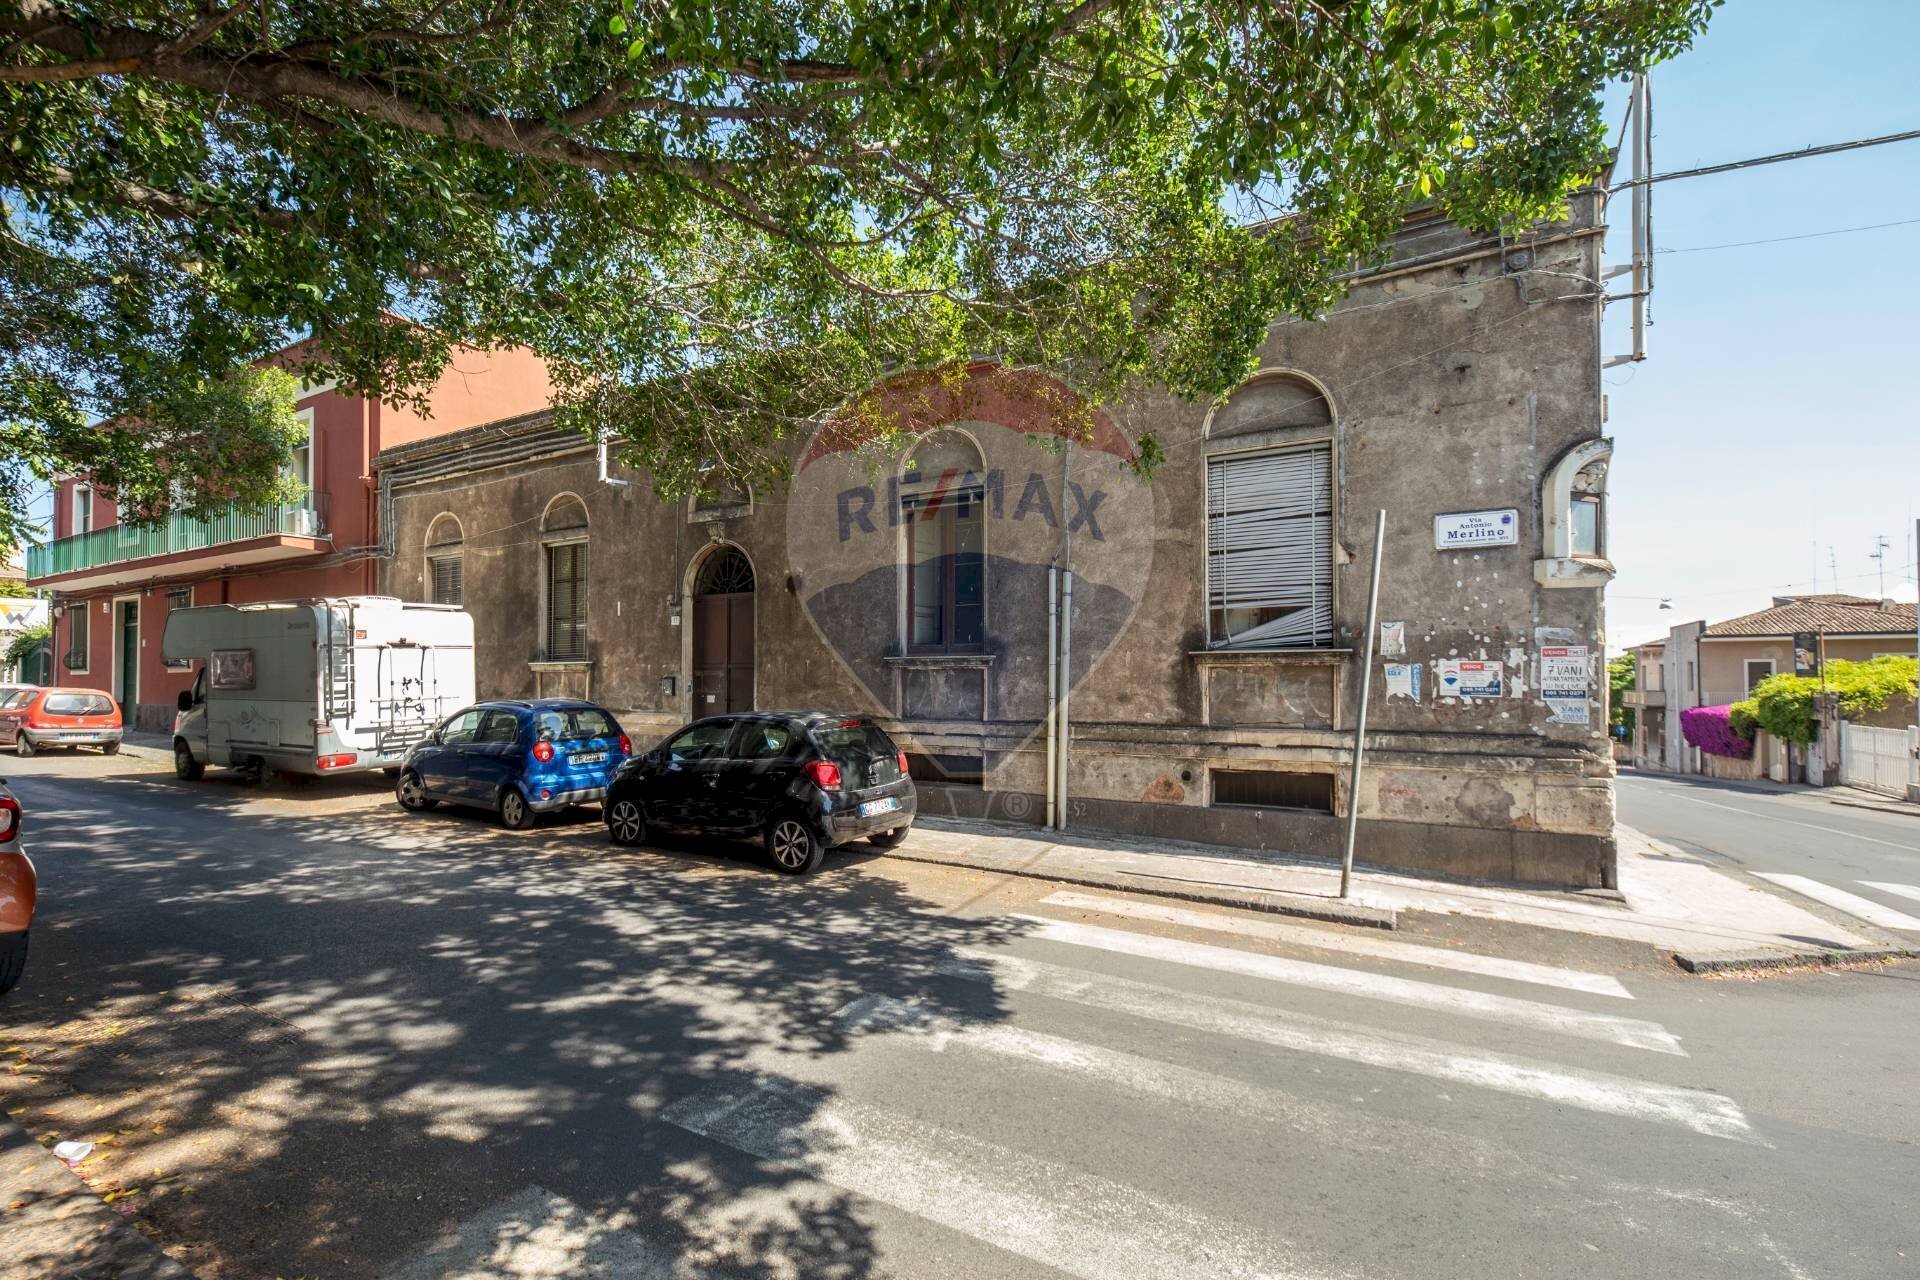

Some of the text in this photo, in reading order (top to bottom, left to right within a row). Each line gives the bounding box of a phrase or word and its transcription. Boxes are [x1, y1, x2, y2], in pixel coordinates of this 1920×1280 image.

[1447, 529, 1505, 539] Merlino
[1547, 665, 1582, 676] 7 VANI
